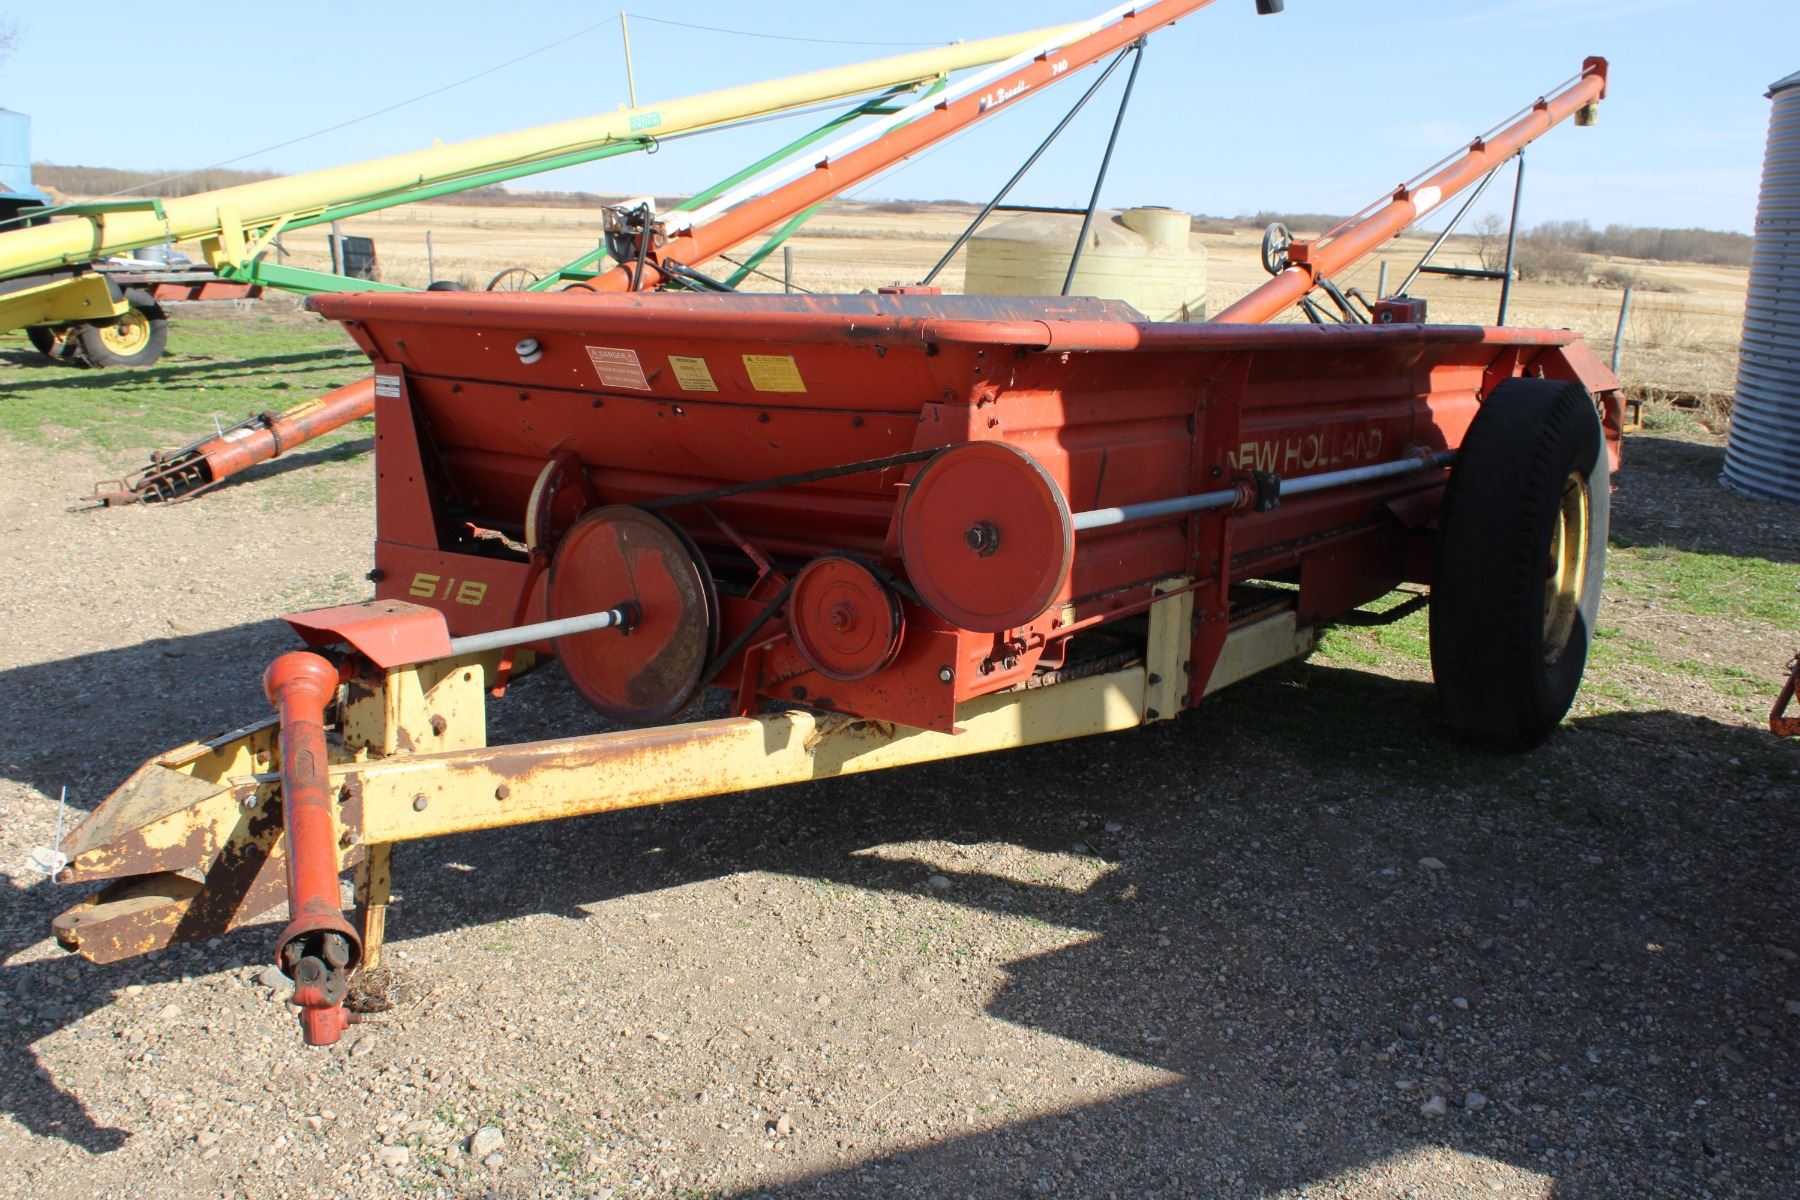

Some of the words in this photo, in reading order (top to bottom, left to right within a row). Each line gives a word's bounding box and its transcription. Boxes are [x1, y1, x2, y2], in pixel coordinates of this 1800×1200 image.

[630, 111, 662, 131] BERGEN
[1284, 429, 1382, 472] HOLLAND
[409, 573, 487, 605] 518
